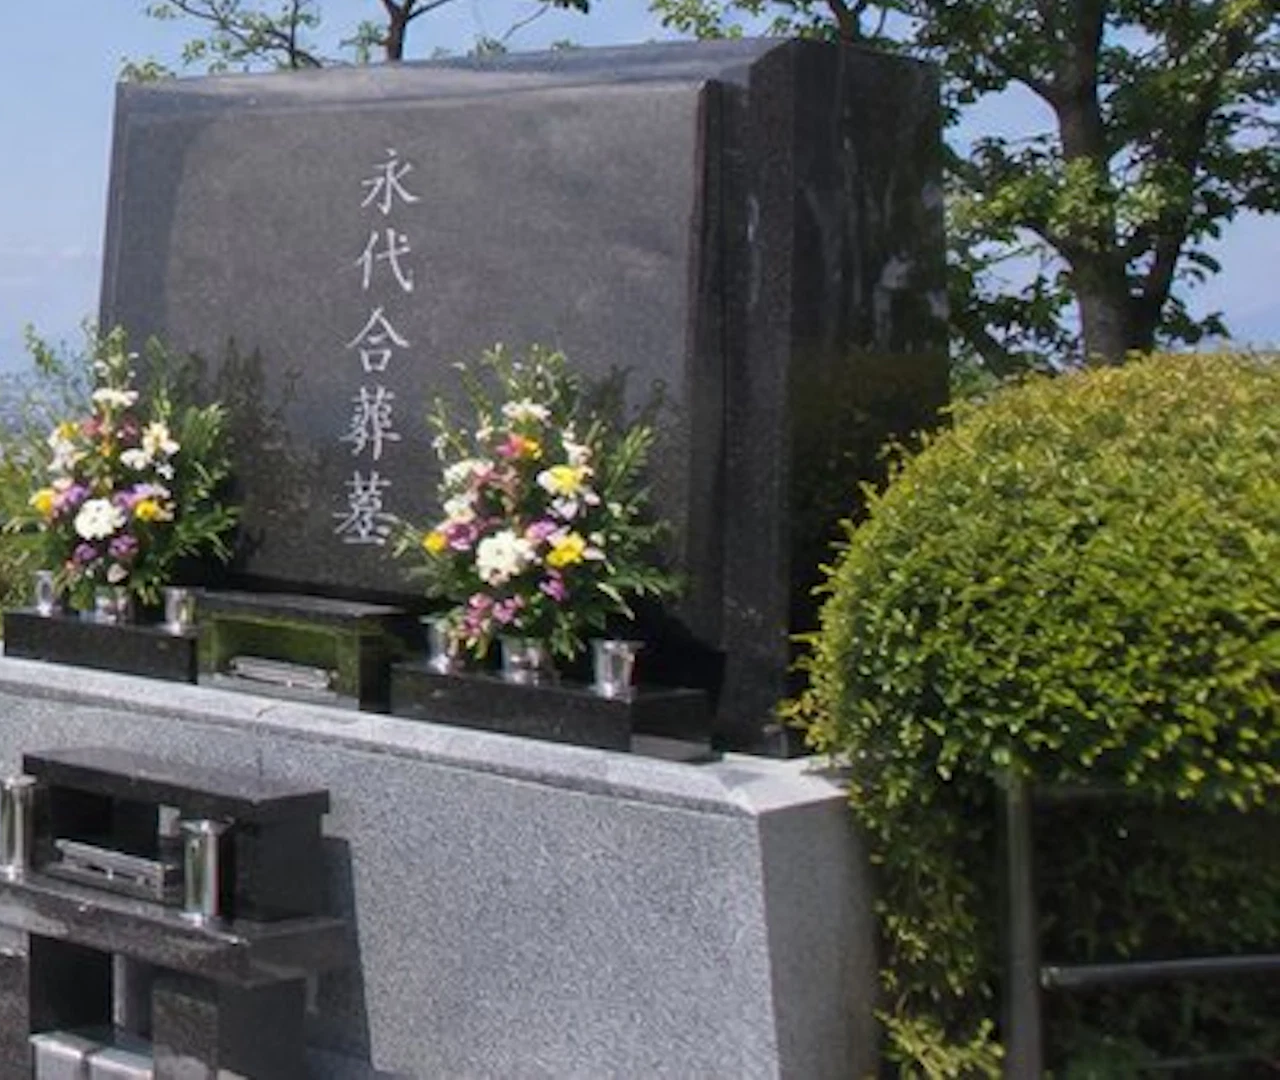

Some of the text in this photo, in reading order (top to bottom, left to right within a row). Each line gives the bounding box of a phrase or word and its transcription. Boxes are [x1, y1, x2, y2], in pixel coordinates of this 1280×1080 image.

[332, 147, 420, 545] 永代合葬墓
